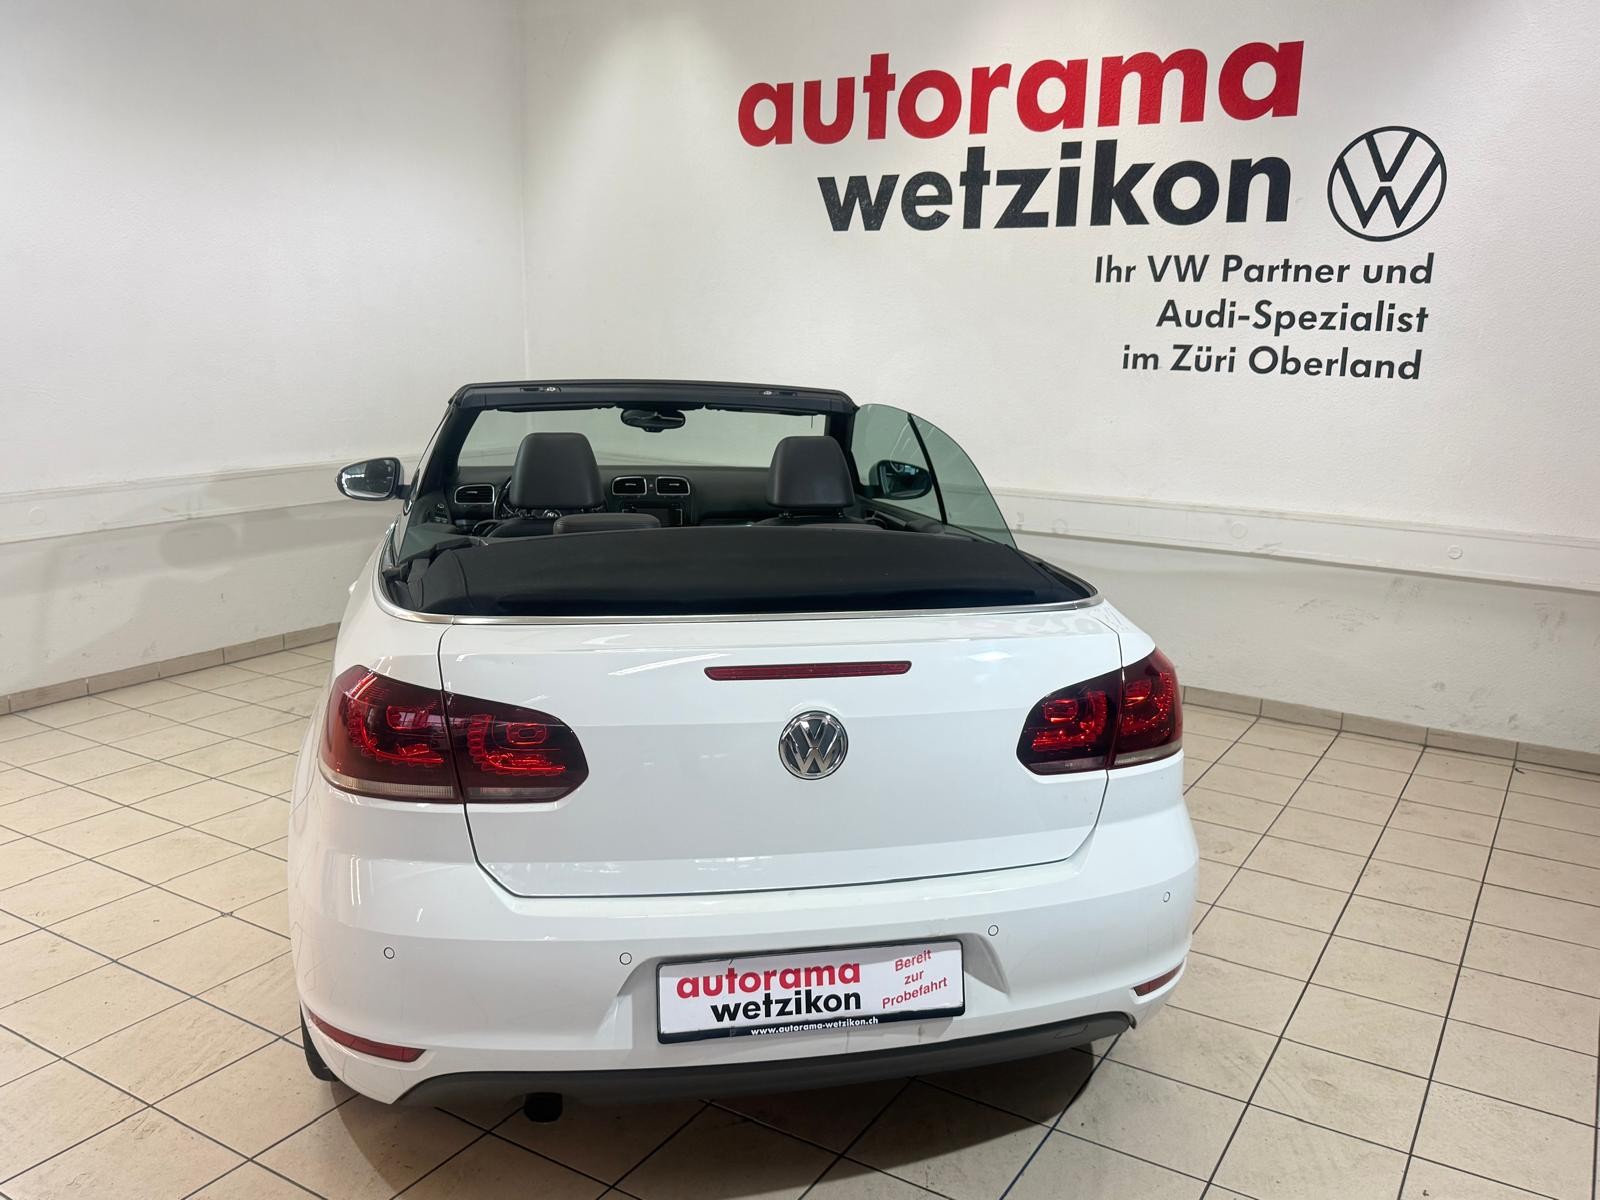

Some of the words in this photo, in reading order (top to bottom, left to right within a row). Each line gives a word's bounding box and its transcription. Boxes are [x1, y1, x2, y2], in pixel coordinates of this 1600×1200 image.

[738, 41, 1304, 146] autorama
[818, 140, 1290, 231] wetzikon
[1095, 254, 1136, 283] Ihr
[1147, 254, 1209, 283] VW
[1223, 254, 1350, 284] Partner
[1363, 253, 1434, 284] und
[1156, 299, 1428, 336] Audi-Spezialist
[1122, 345, 1158, 370] im
[1171, 344, 1236, 373] Züri
[1249, 346, 1422, 380] Oberland
[895, 949, 932, 972] Bereit
[676, 962, 860, 999] autorama
[881, 976, 948, 1009] Probefahrt
[904, 970, 924, 985] zur
[711, 989, 861, 1022] wetzikon
[751, 1016, 879, 1036] www.autorama-wetzikon.ch
